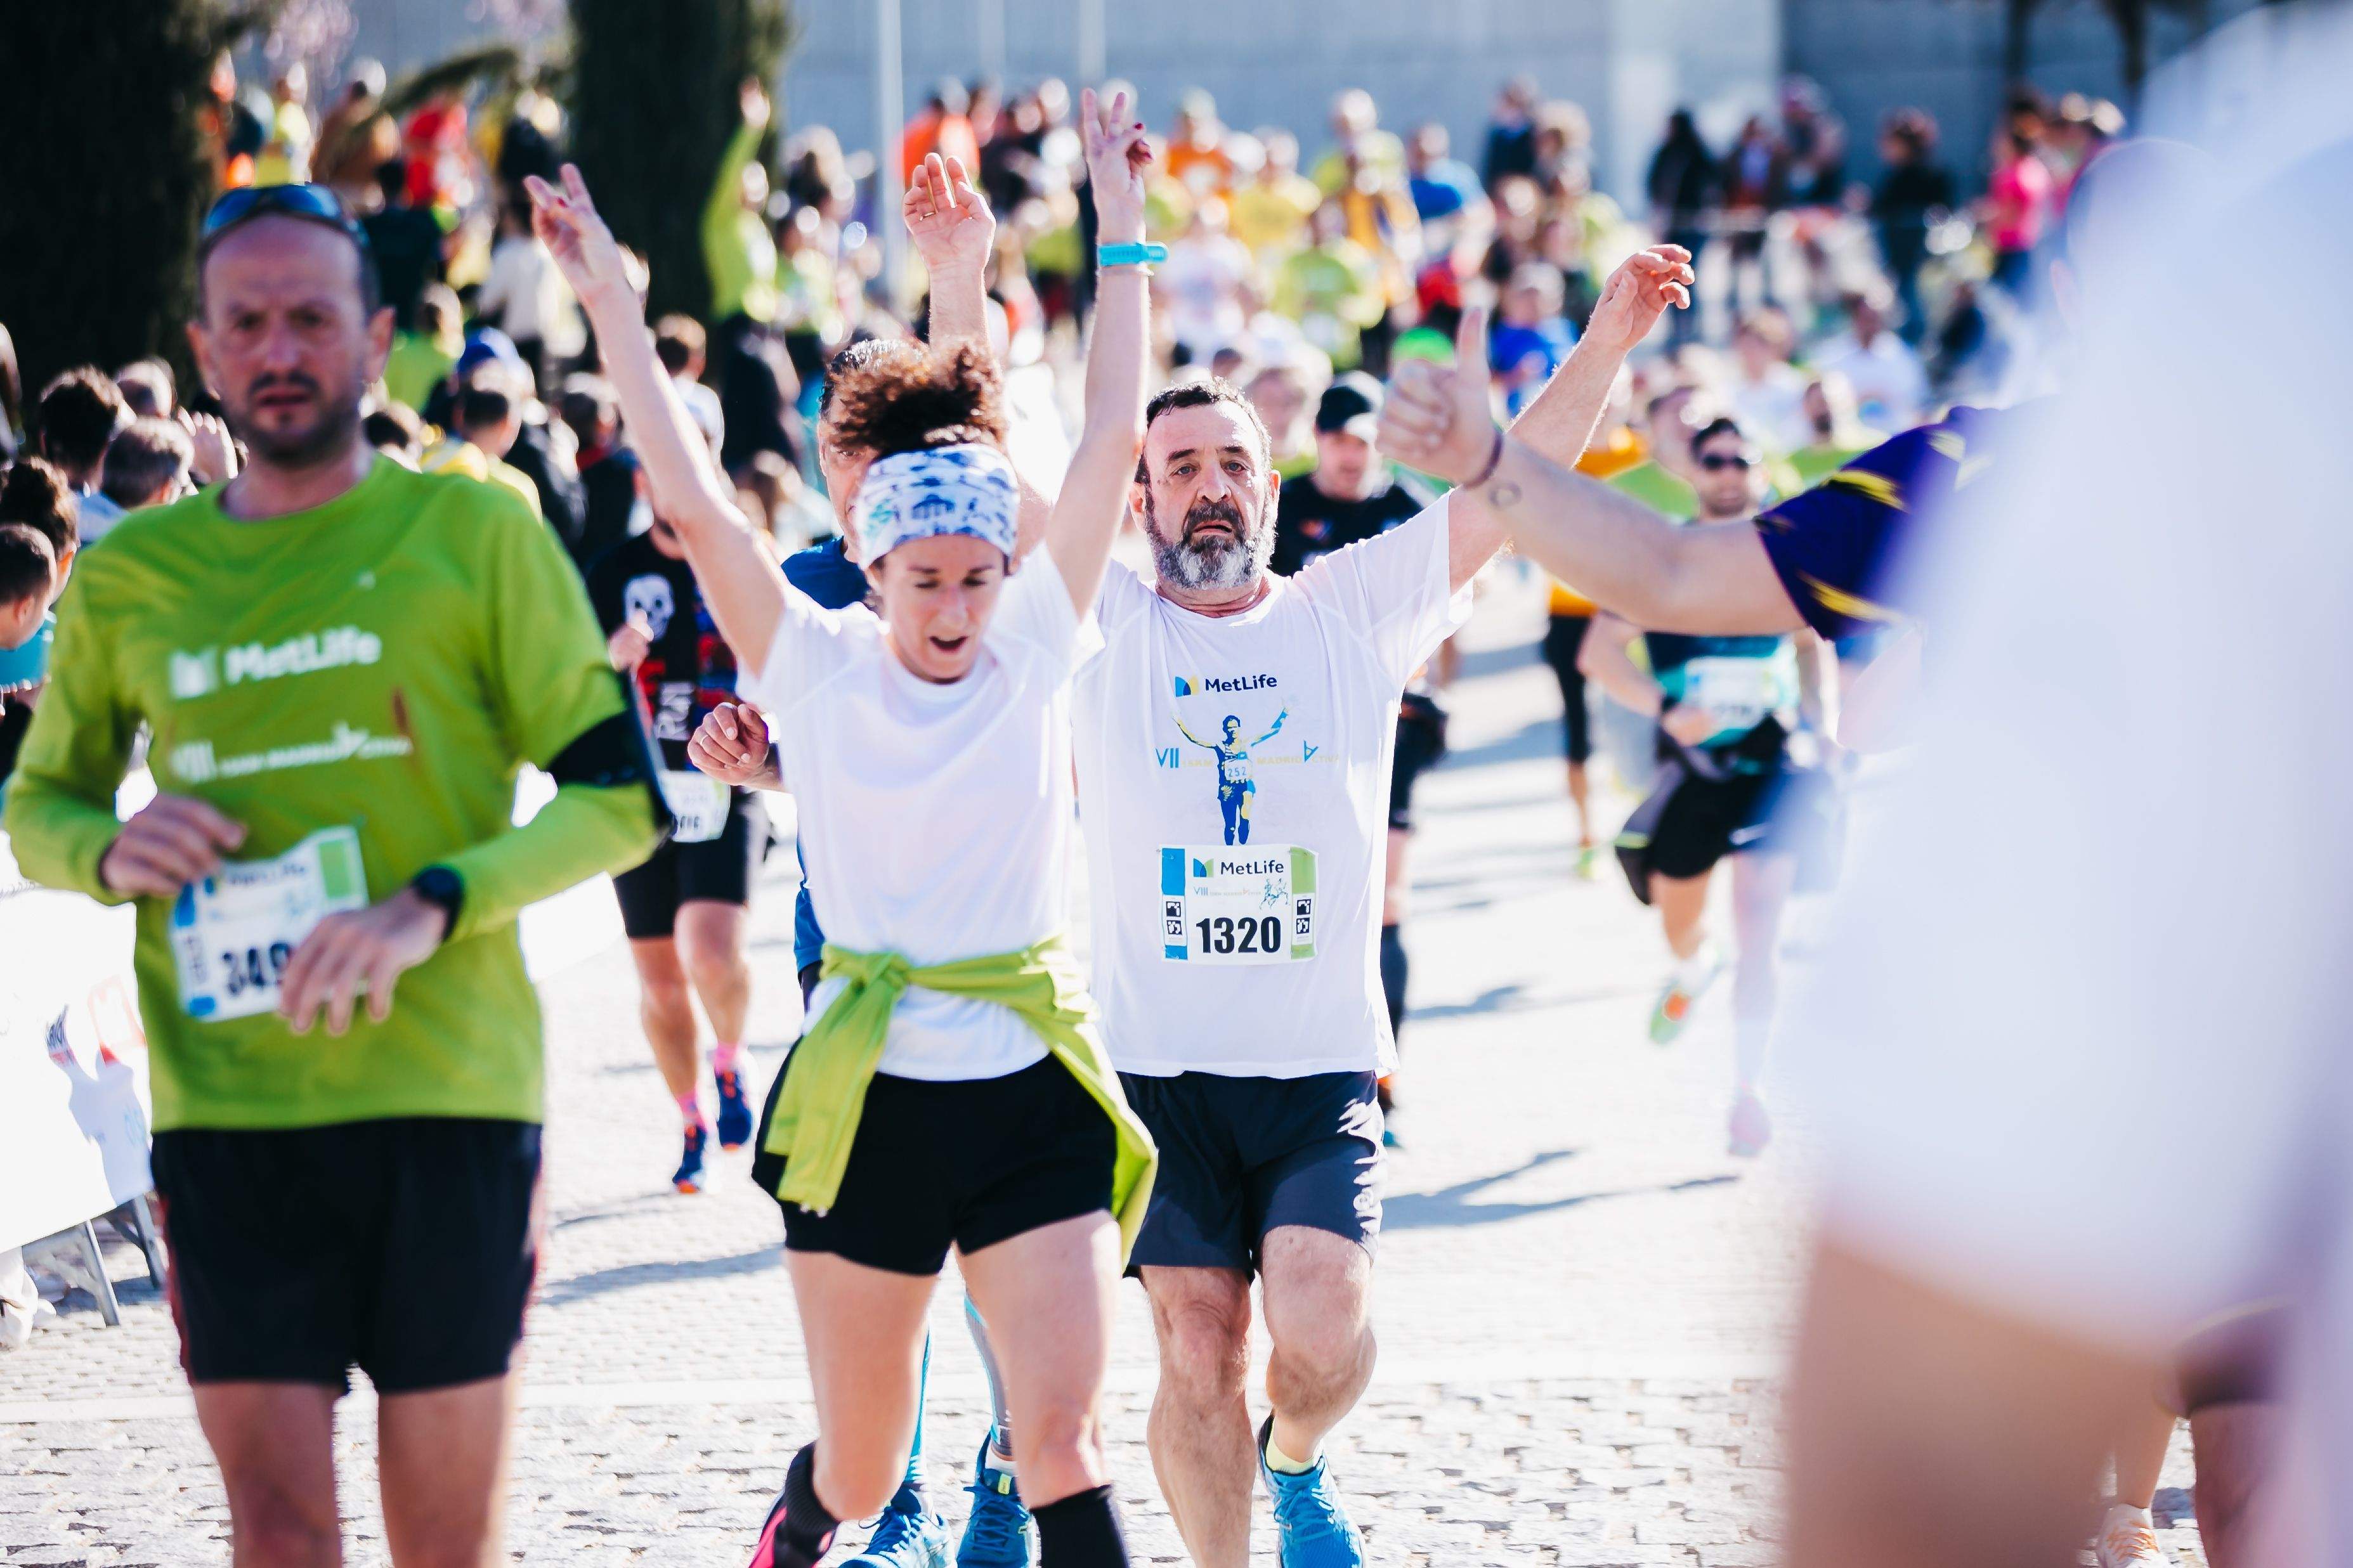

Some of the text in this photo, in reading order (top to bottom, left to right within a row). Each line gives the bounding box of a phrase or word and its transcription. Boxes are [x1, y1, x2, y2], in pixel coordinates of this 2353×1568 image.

[224, 625, 382, 685] MetLife
[1205, 674, 1277, 692] MetLife
[1156, 748, 1180, 768] VII
[1228, 767, 1247, 777] 252
[1221, 860, 1284, 875] MetLife
[1196, 916, 1281, 954] 1320
